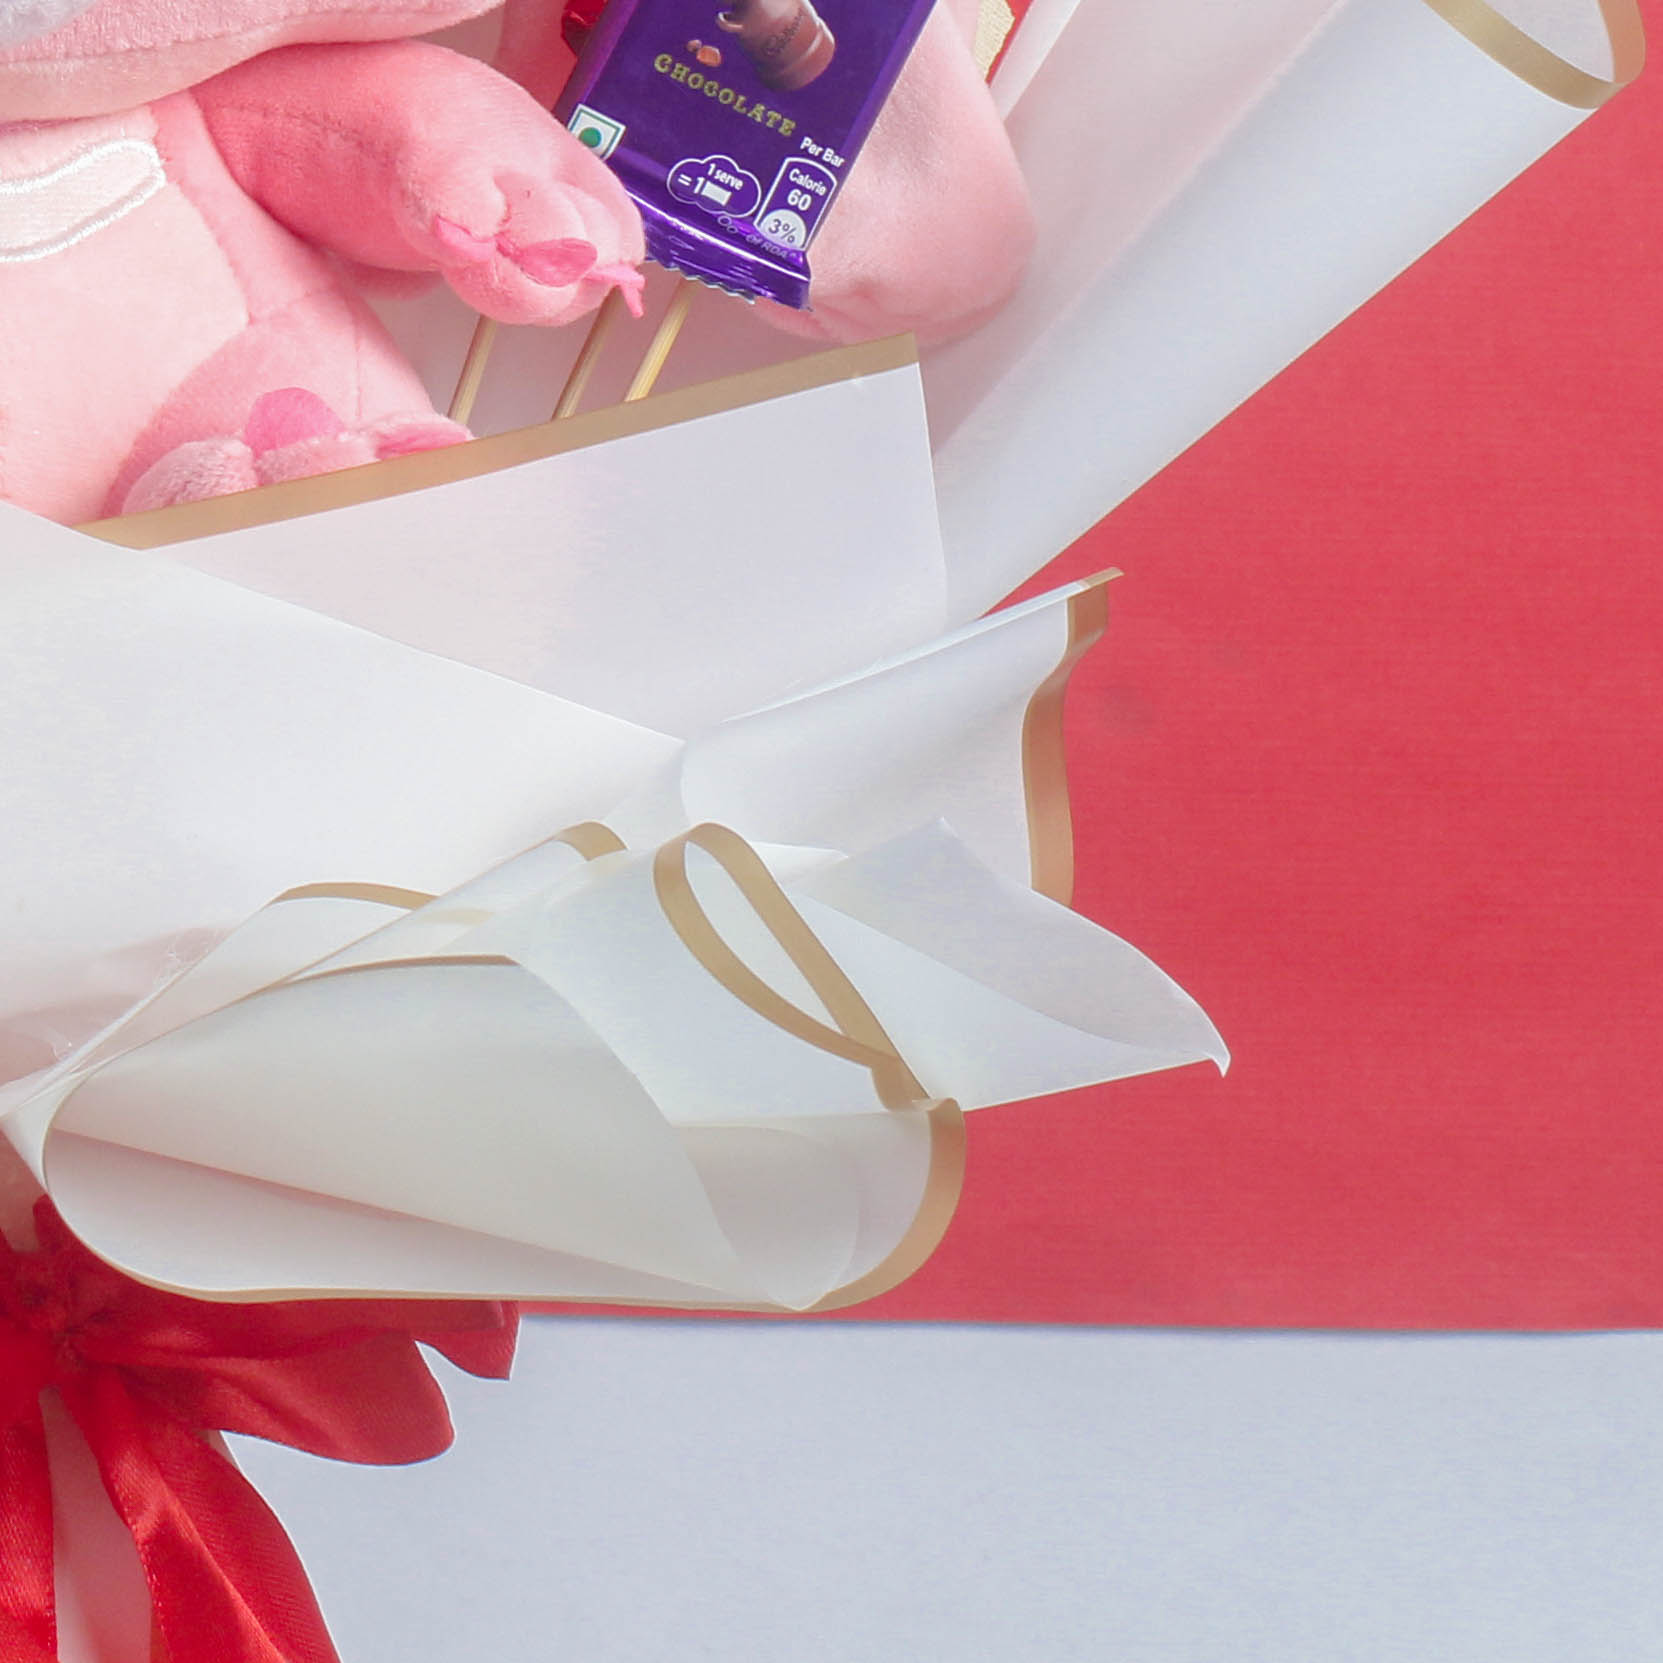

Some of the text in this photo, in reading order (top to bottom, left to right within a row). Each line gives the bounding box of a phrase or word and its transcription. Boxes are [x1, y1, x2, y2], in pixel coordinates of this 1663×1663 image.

[654, 53, 796, 136] CHOCOLATE
[800, 137, 845, 168] Per Bar
[714, 169, 744, 190] serve
[789, 168, 828, 197] Calorie
[787, 190, 812, 212] 60
[768, 218, 797, 244] 3%
